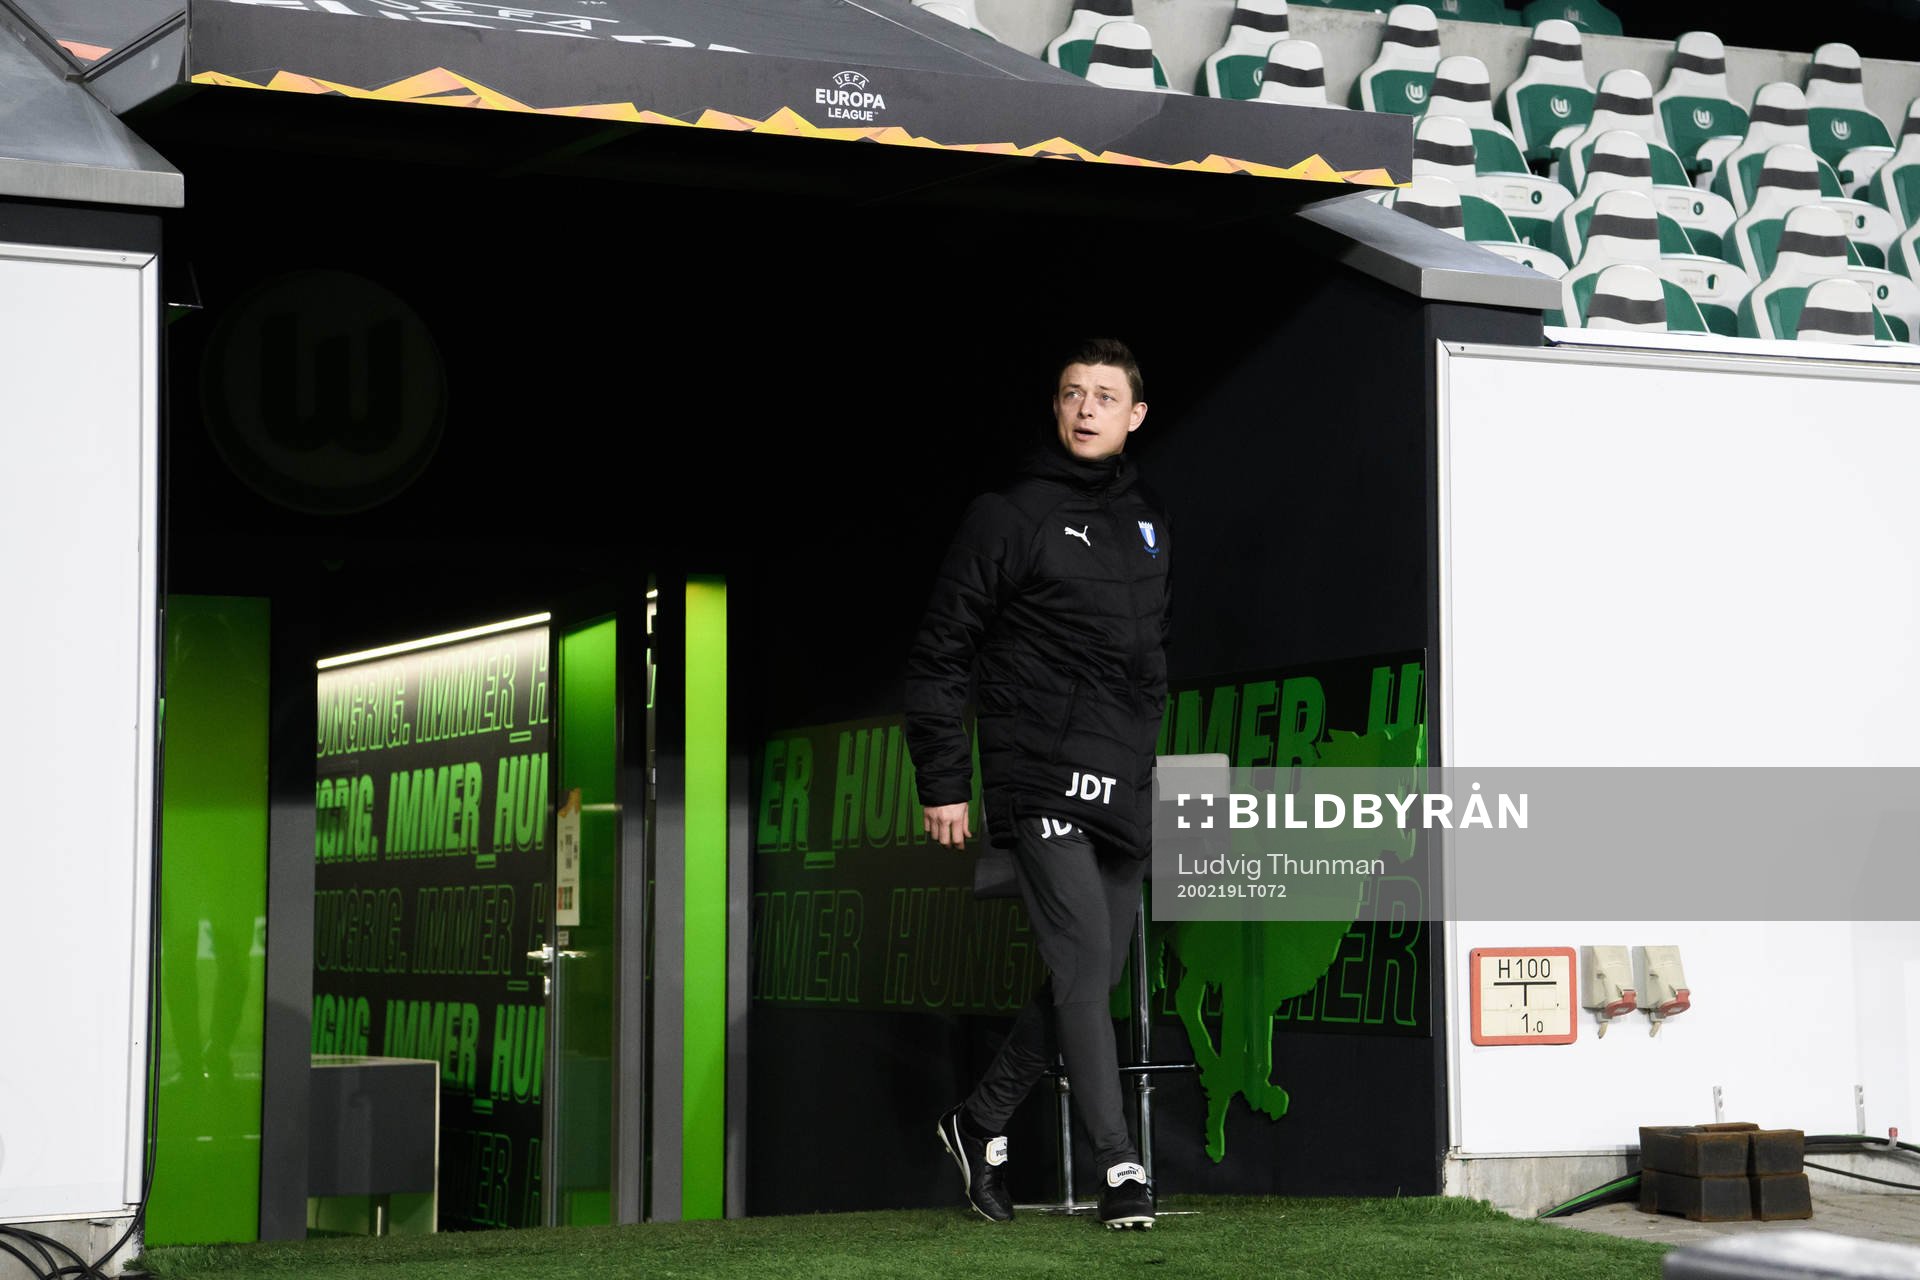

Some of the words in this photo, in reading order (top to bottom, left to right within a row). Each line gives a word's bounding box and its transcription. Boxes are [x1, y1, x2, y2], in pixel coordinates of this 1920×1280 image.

[834, 73, 866, 88] UEFA
[815, 88, 886, 110] EUROPA
[1065, 771, 1117, 805] JDT
[1041, 817, 1083, 839] JD
